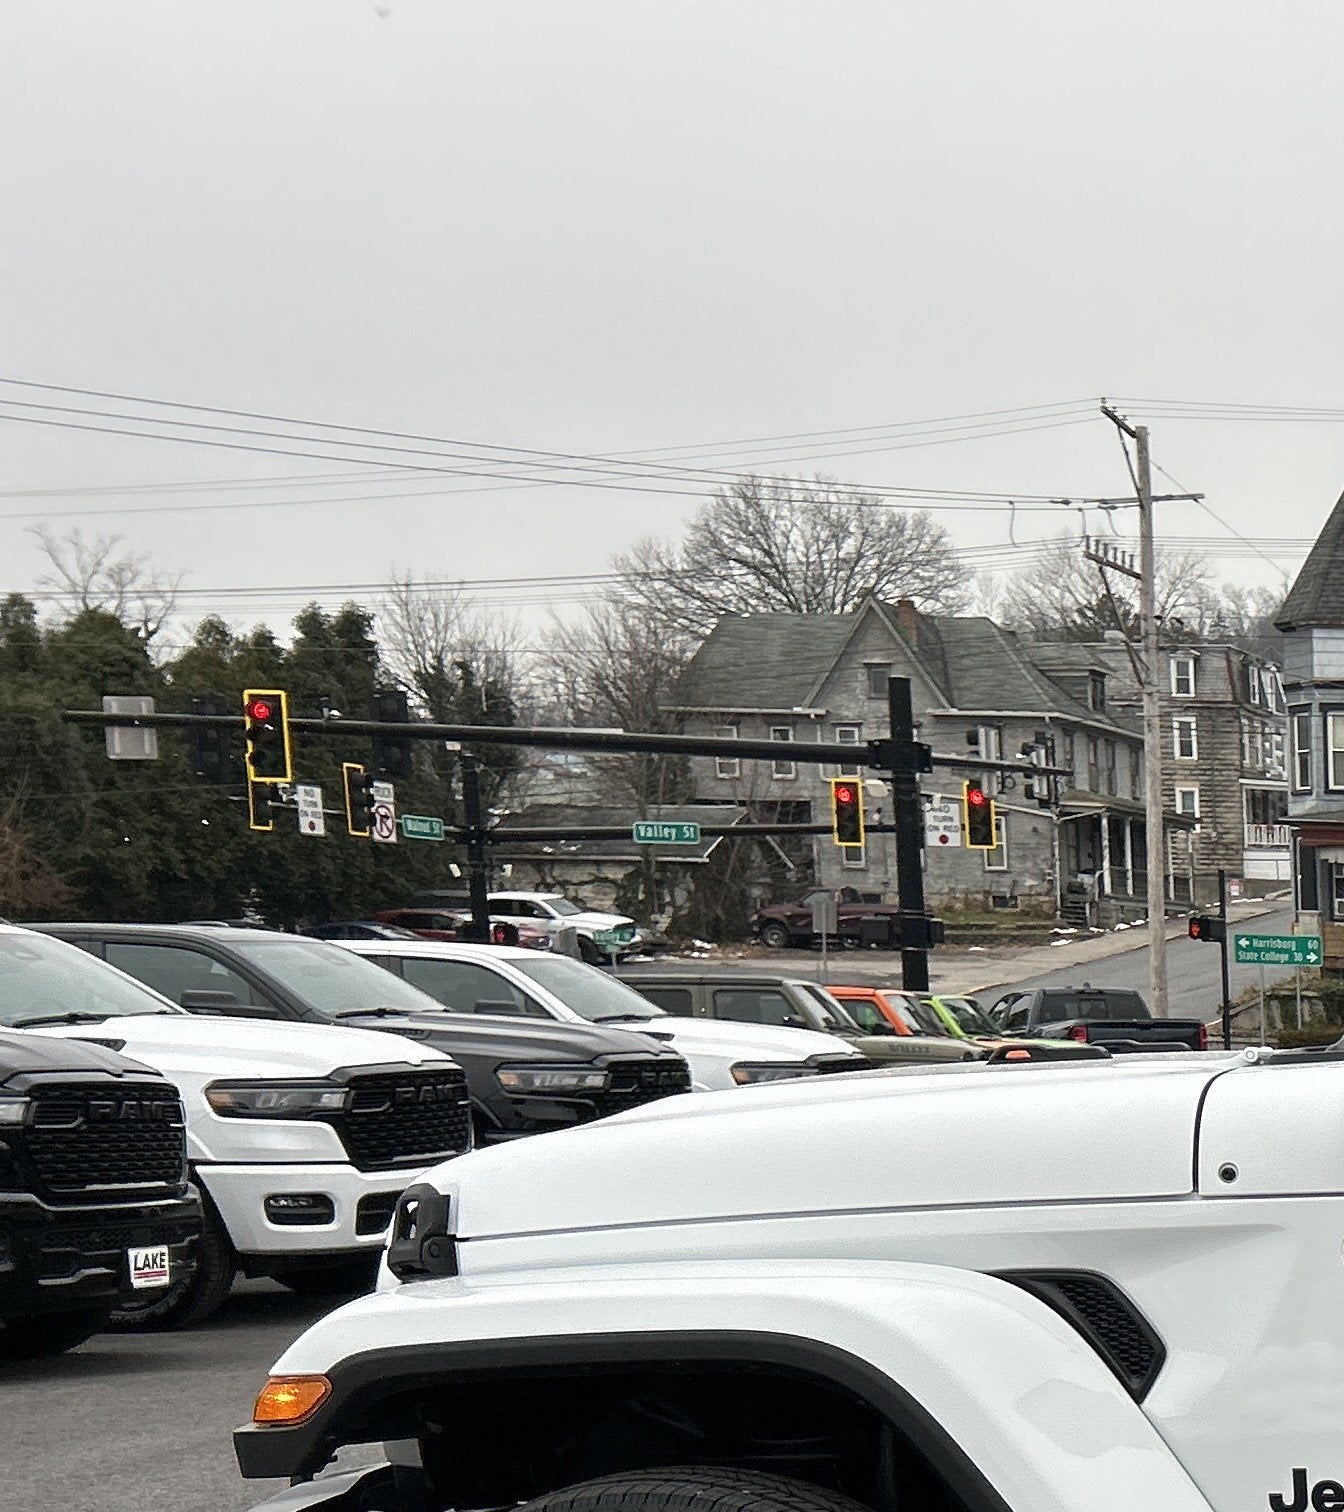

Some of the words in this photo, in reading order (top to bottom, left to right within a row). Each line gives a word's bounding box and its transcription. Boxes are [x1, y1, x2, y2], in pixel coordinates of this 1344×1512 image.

[637, 824, 677, 841] Valley
[682, 825, 695, 838] St
[1252, 938, 1297, 951] Harrisburg
[1237, 950, 1259, 961] State
[1260, 951, 1289, 963] College
[134, 1251, 167, 1271] LAKE
